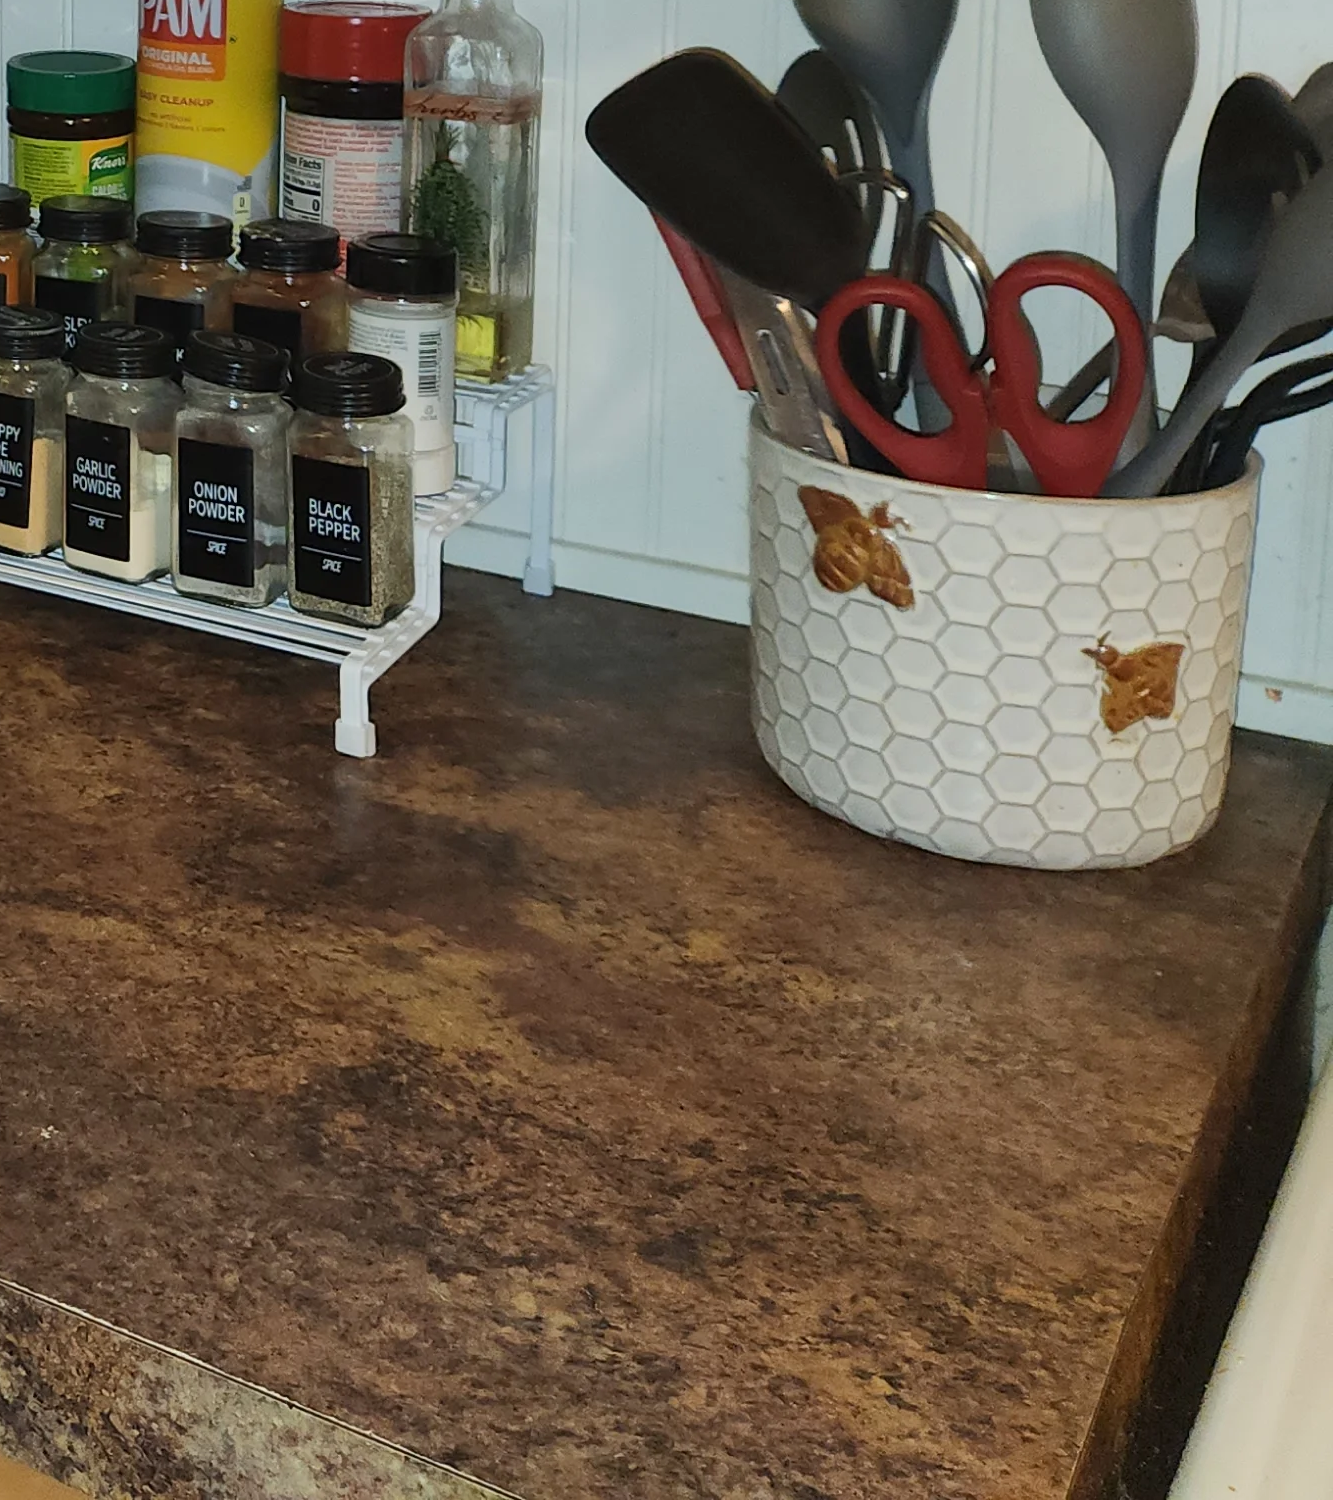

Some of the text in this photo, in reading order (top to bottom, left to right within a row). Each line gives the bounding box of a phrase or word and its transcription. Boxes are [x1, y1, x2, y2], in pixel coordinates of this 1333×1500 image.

[141, 45, 212, 66] ORIGINAL
[159, 93, 214, 108] CLEANUP
[299, 156, 322, 171] Facts
[76, 457, 117, 481] GARLIC
[72, 473, 122, 500] POWDER
[193, 481, 238, 503] ONION
[188, 498, 245, 523] POWDER
[308, 498, 352, 523] BLACK
[308, 518, 361, 542] PEPPER
